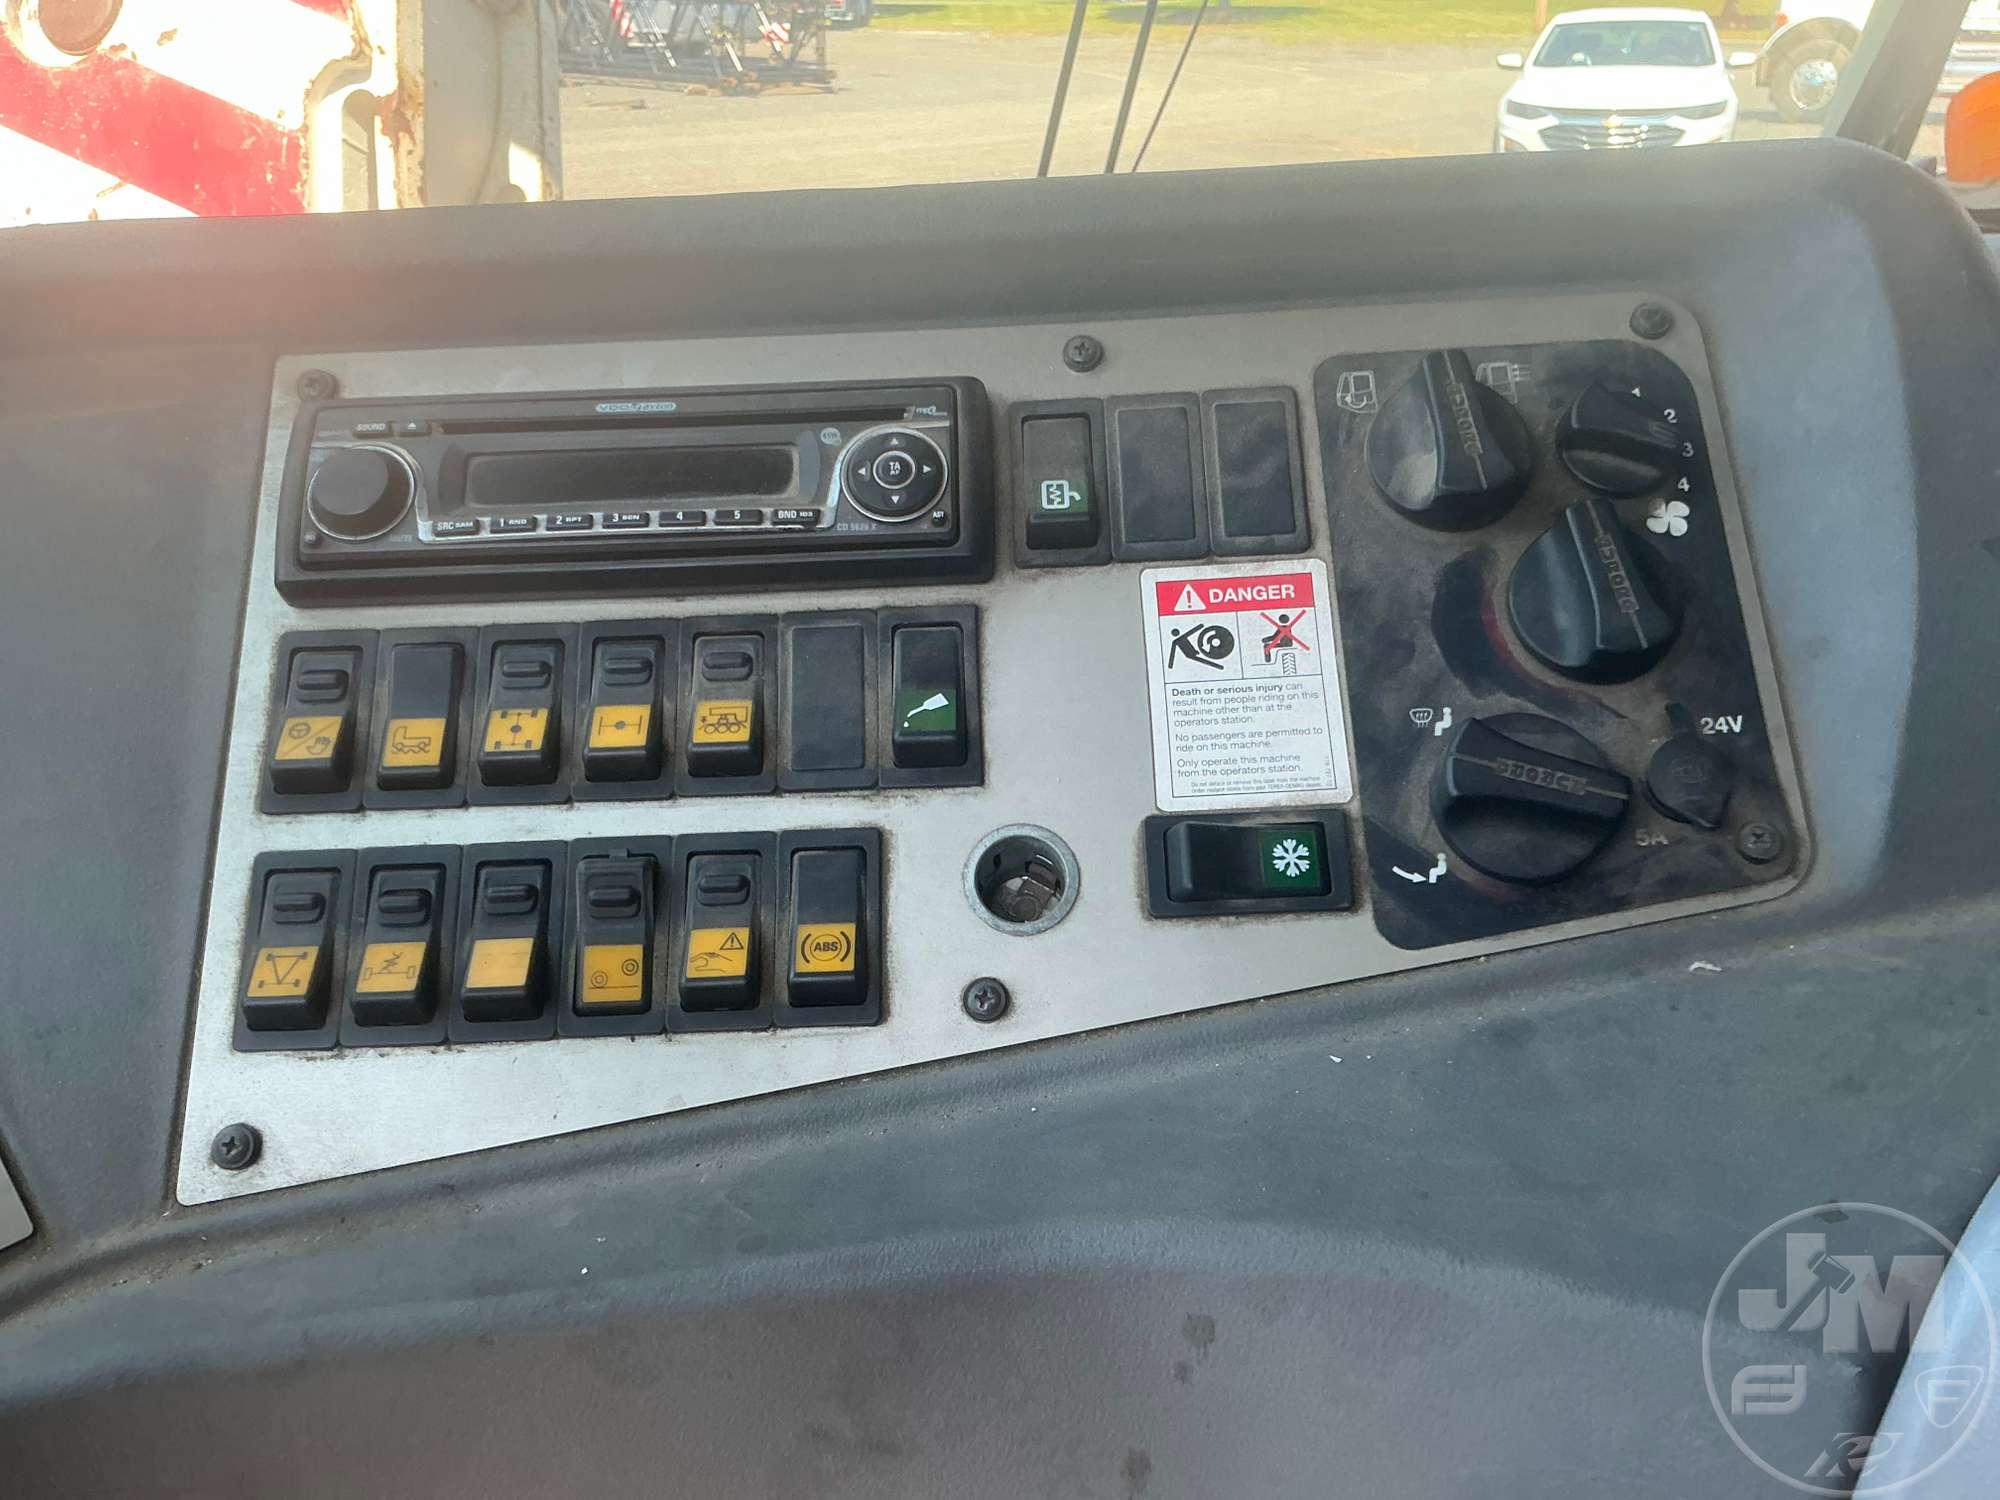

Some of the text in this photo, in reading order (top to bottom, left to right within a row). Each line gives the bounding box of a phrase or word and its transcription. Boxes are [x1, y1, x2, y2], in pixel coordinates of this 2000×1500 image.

[1663, 408, 1677, 424] 2
[356, 422, 386, 431] SOUND
[1681, 441, 1694, 457] 3
[889, 461, 901, 471] TA
[1679, 476, 1690, 492] 4
[612, 513, 619, 522] 3
[676, 511, 683, 521] 4
[734, 510, 741, 520] 5
[778, 509, 797, 519] BND
[932, 510, 945, 520] AST
[437, 521, 454, 531] SRC
[500, 518, 505, 528] 1
[556, 515, 563, 526] 2
[1209, 585, 1295, 603] DANGER
[1172, 688, 1202, 697] Death
[1217, 685, 1254, 694] serious
[1256, 682, 1283, 693] injury
[1173, 691, 1319, 707] result from people riding on this
[1173, 702, 1293, 718] machine other than at the
[1174, 717, 1219, 728] operators
[1700, 714, 1743, 734] 24V
[1175, 725, 1324, 743] No passengers are permitted to
[1176, 742, 1194, 752] ride
[1210, 741, 1228, 750] this
[1176, 752, 1301, 768] Only operate this machine
[1178, 768, 1200, 778] from
[1202, 767, 1218, 776] the
[1219, 763, 1266, 776] operators
[1636, 829, 1670, 846] 5A
[814, 941, 839, 952] ABS
